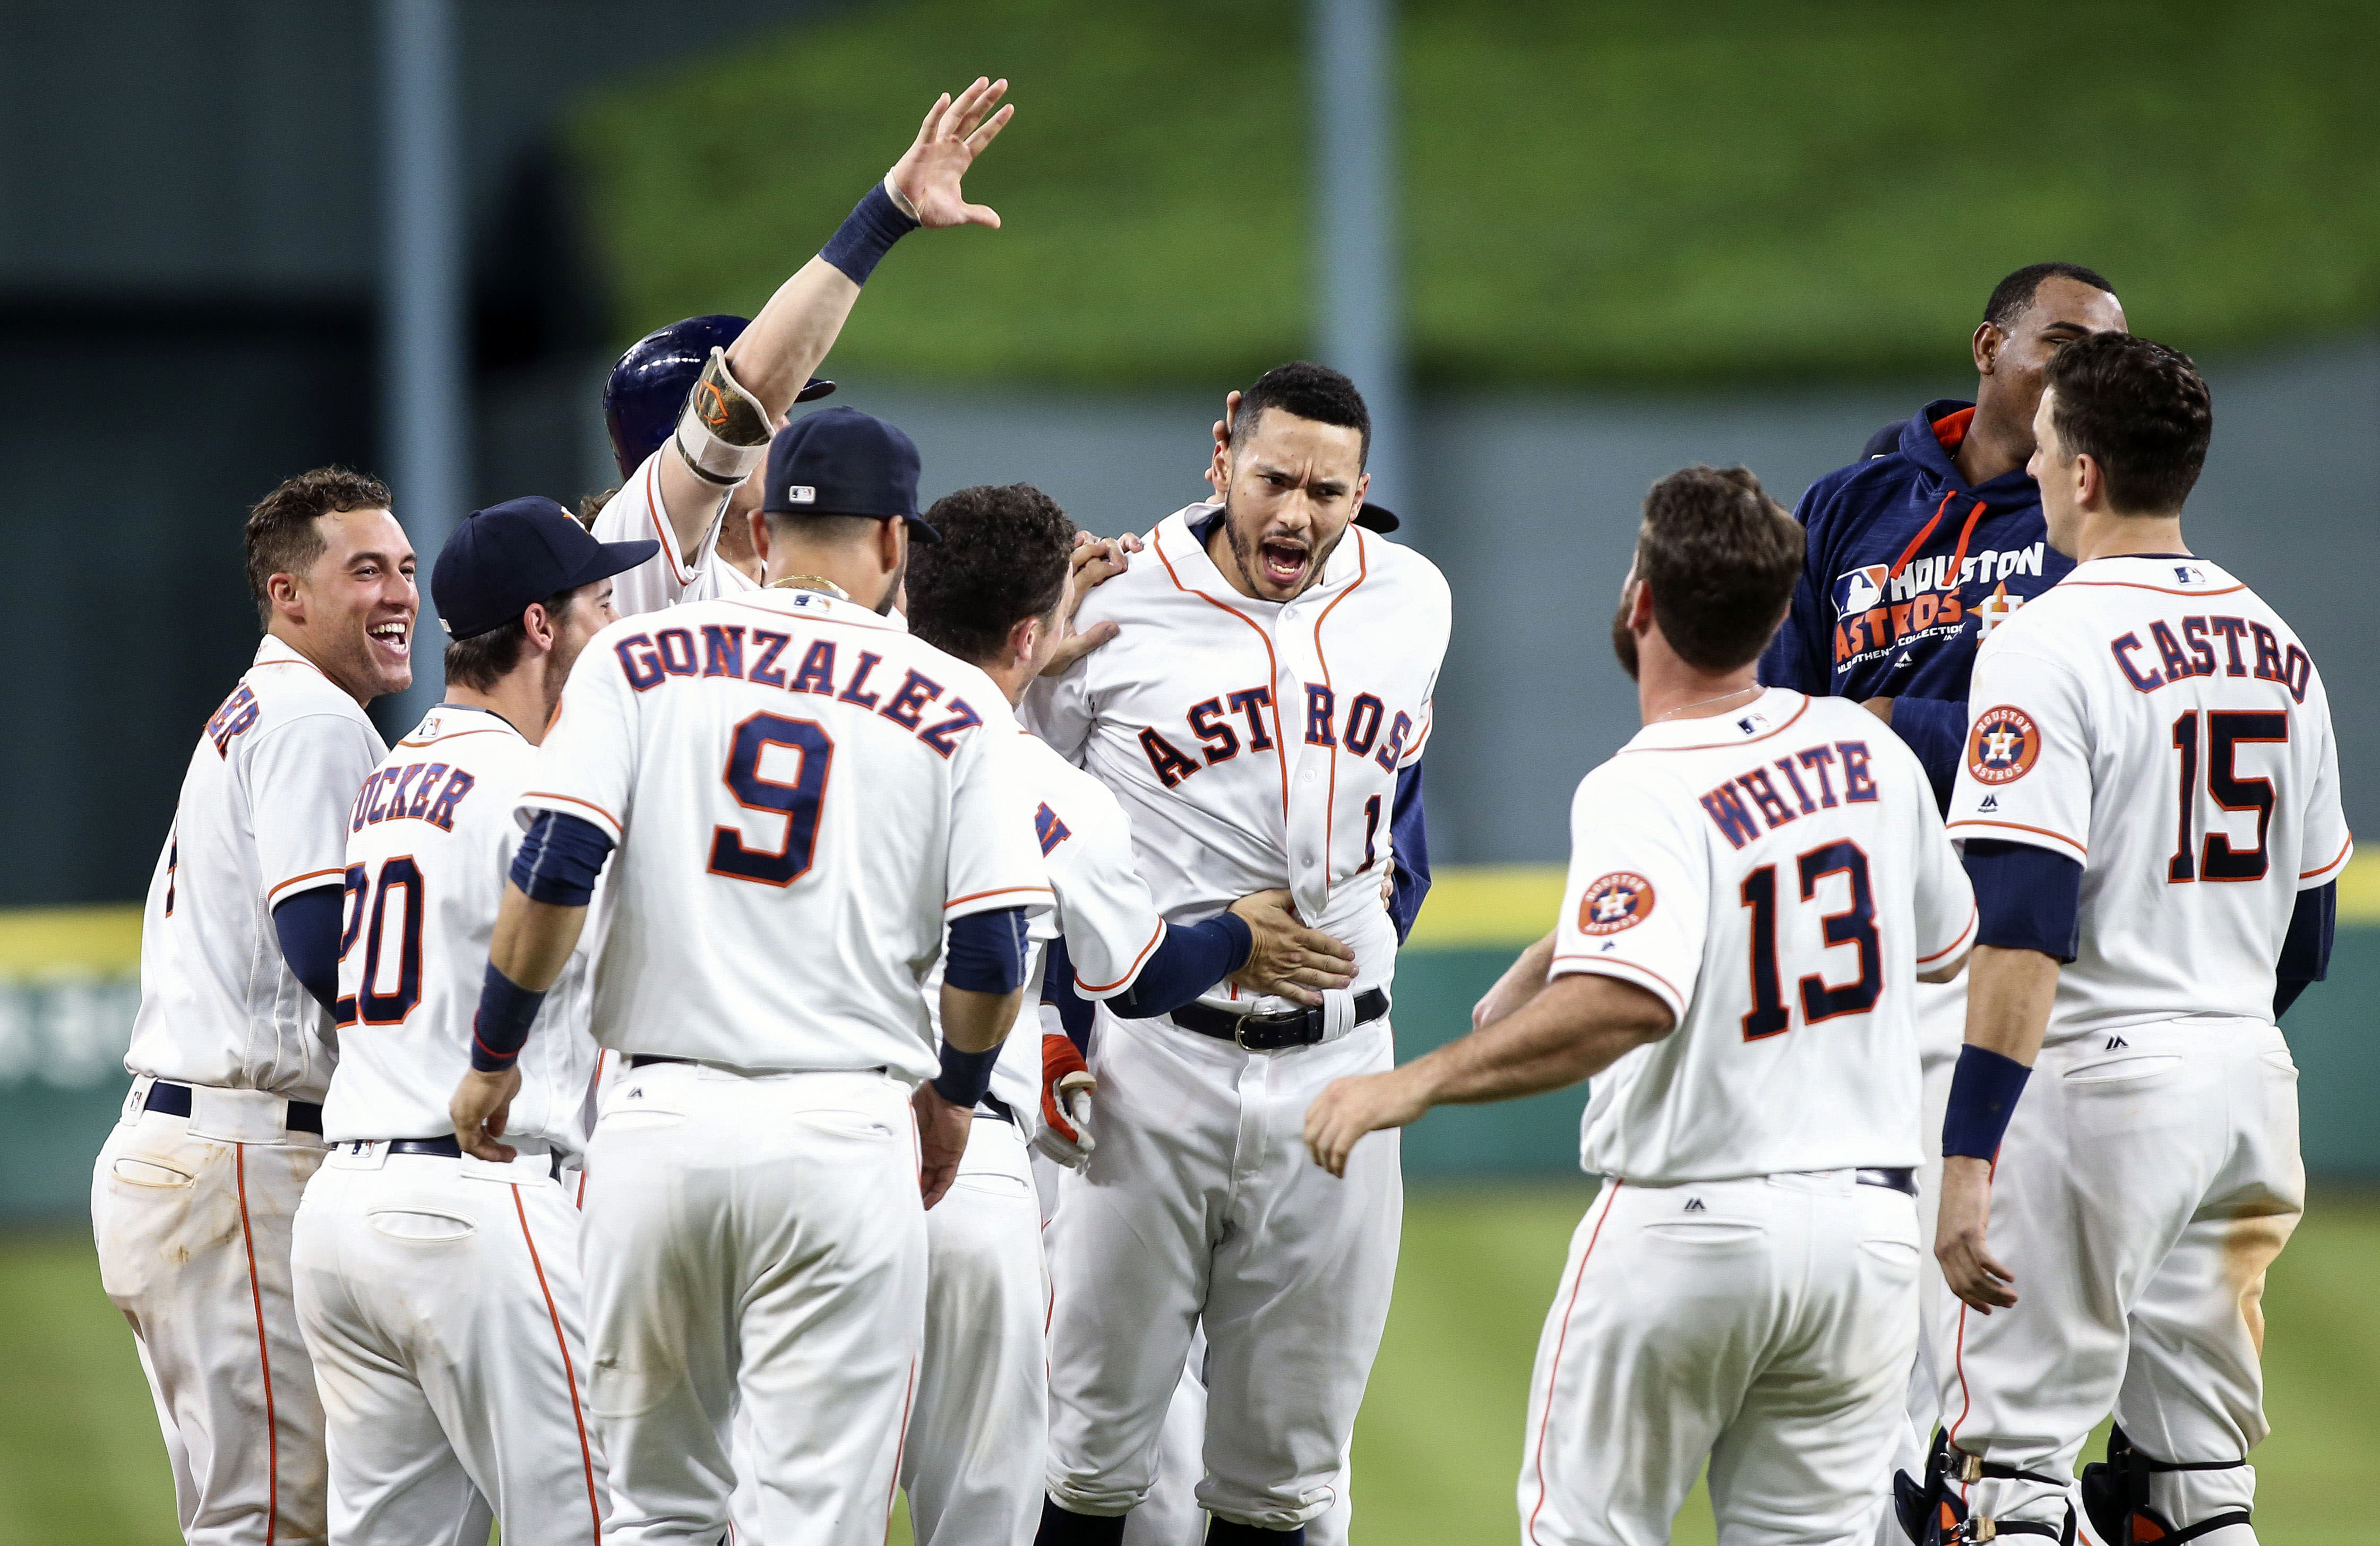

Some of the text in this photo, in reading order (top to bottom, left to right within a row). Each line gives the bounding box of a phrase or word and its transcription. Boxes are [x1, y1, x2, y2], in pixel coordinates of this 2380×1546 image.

[1890, 542, 2045, 602] HOUSTON
[1835, 587, 1962, 664] ASTROS
[1837, 660, 1852, 674] MLB
[1897, 622, 1966, 647] COLLECTION
[2111, 615, 2311, 705] CASTRO
[614, 625, 983, 759] GONZALEZ
[1975, 709, 2032, 733] HOUSTON
[1137, 682, 1413, 788] ASTROS
[1972, 762, 2023, 780] ASTROS
[346, 762, 475, 833] UCKER
[707, 709, 834, 888] 9
[1355, 794, 1381, 874] 1
[1699, 740, 1879, 849] WHITE
[2168, 709, 2289, 883] 15
[1740, 836, 1885, 1042] 13
